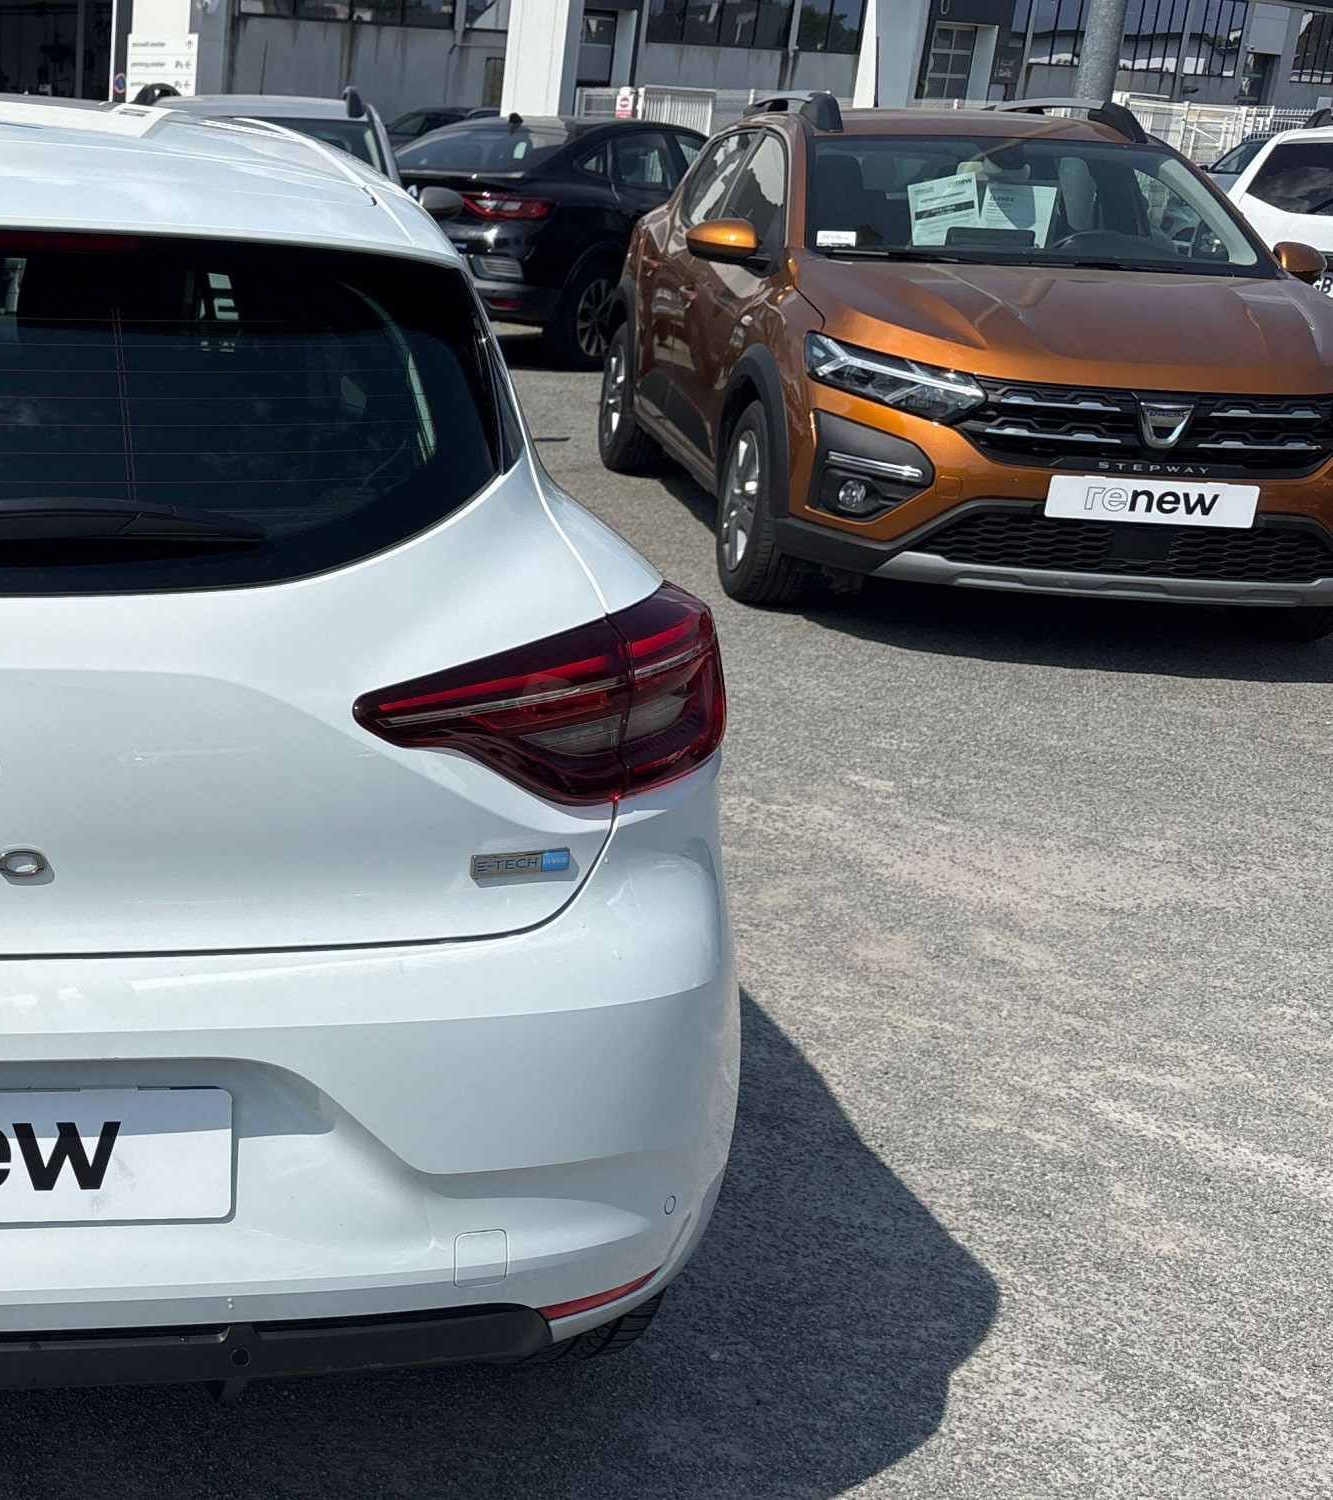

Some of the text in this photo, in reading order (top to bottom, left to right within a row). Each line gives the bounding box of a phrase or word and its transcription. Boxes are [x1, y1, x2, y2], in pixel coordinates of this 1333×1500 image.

[1148, 408, 1186, 419] DACIA
[1098, 461, 1210, 475] STEPWAY
[1084, 486, 1220, 516] renew
[477, 857, 538, 873] E-TECH
